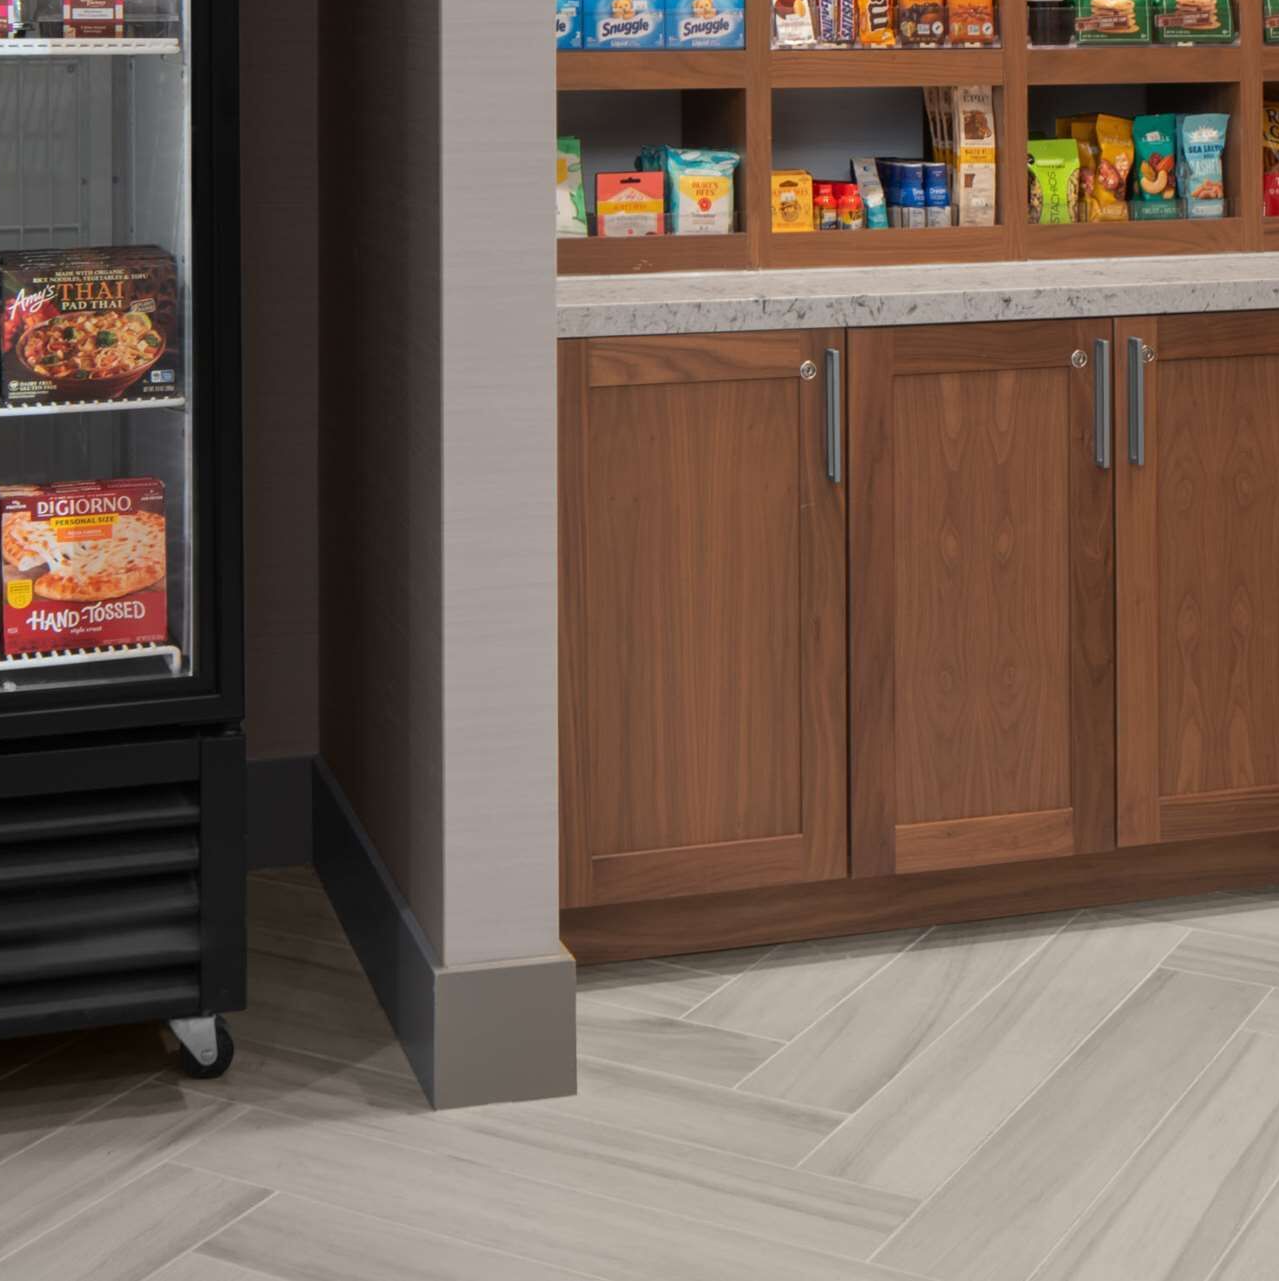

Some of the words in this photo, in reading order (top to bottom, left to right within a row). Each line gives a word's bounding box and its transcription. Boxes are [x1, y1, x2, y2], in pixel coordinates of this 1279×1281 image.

[602, 18, 649, 37] Snuggle
[683, 18, 730, 36] Snuggle
[58, 281, 125, 301] THAI
[8, 284, 56, 320] Amy's
[62, 301, 87, 311] PAD
[91, 300, 122, 309] THAI
[55, 517, 96, 526] PERSONAL
[26, 601, 145, 632] HAND-TOSSED
